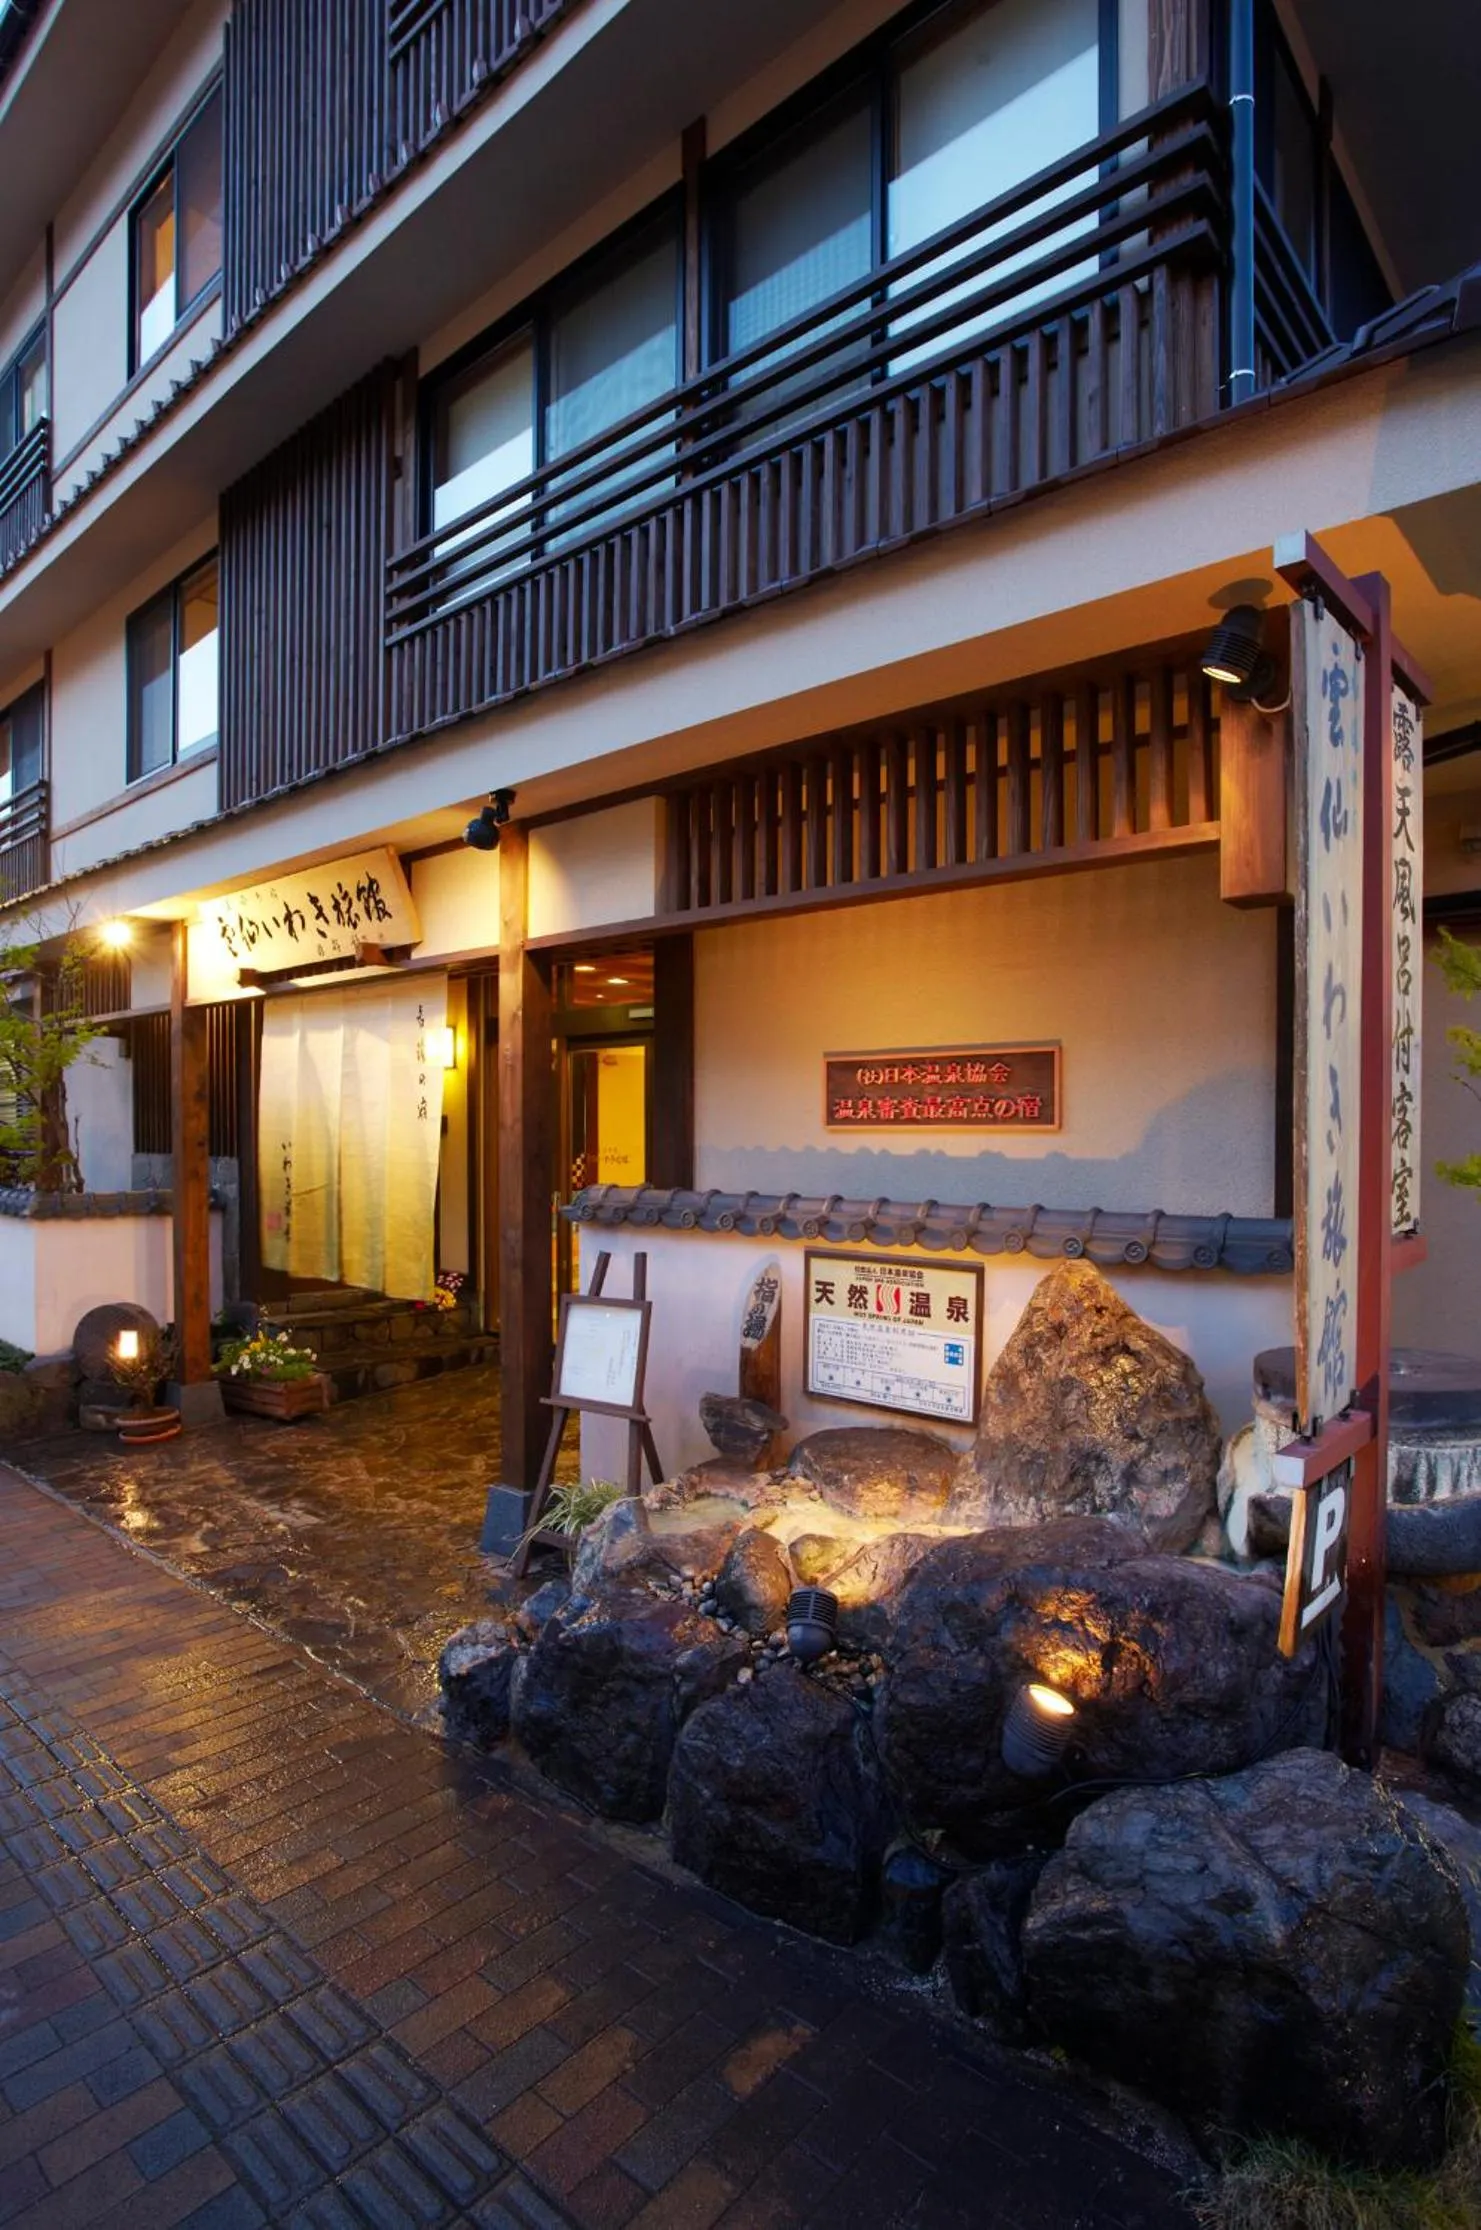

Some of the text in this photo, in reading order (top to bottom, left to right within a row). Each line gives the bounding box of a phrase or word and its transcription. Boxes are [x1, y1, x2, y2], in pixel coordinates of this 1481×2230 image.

[833, 1094, 1042, 1119] 温泉審査最高点の宿
[1318, 641, 1349, 1399] 雲仙いわき旅館
[1392, 702, 1416, 1227] 露天風呂付客室
[1311, 1486, 1345, 1592] P
